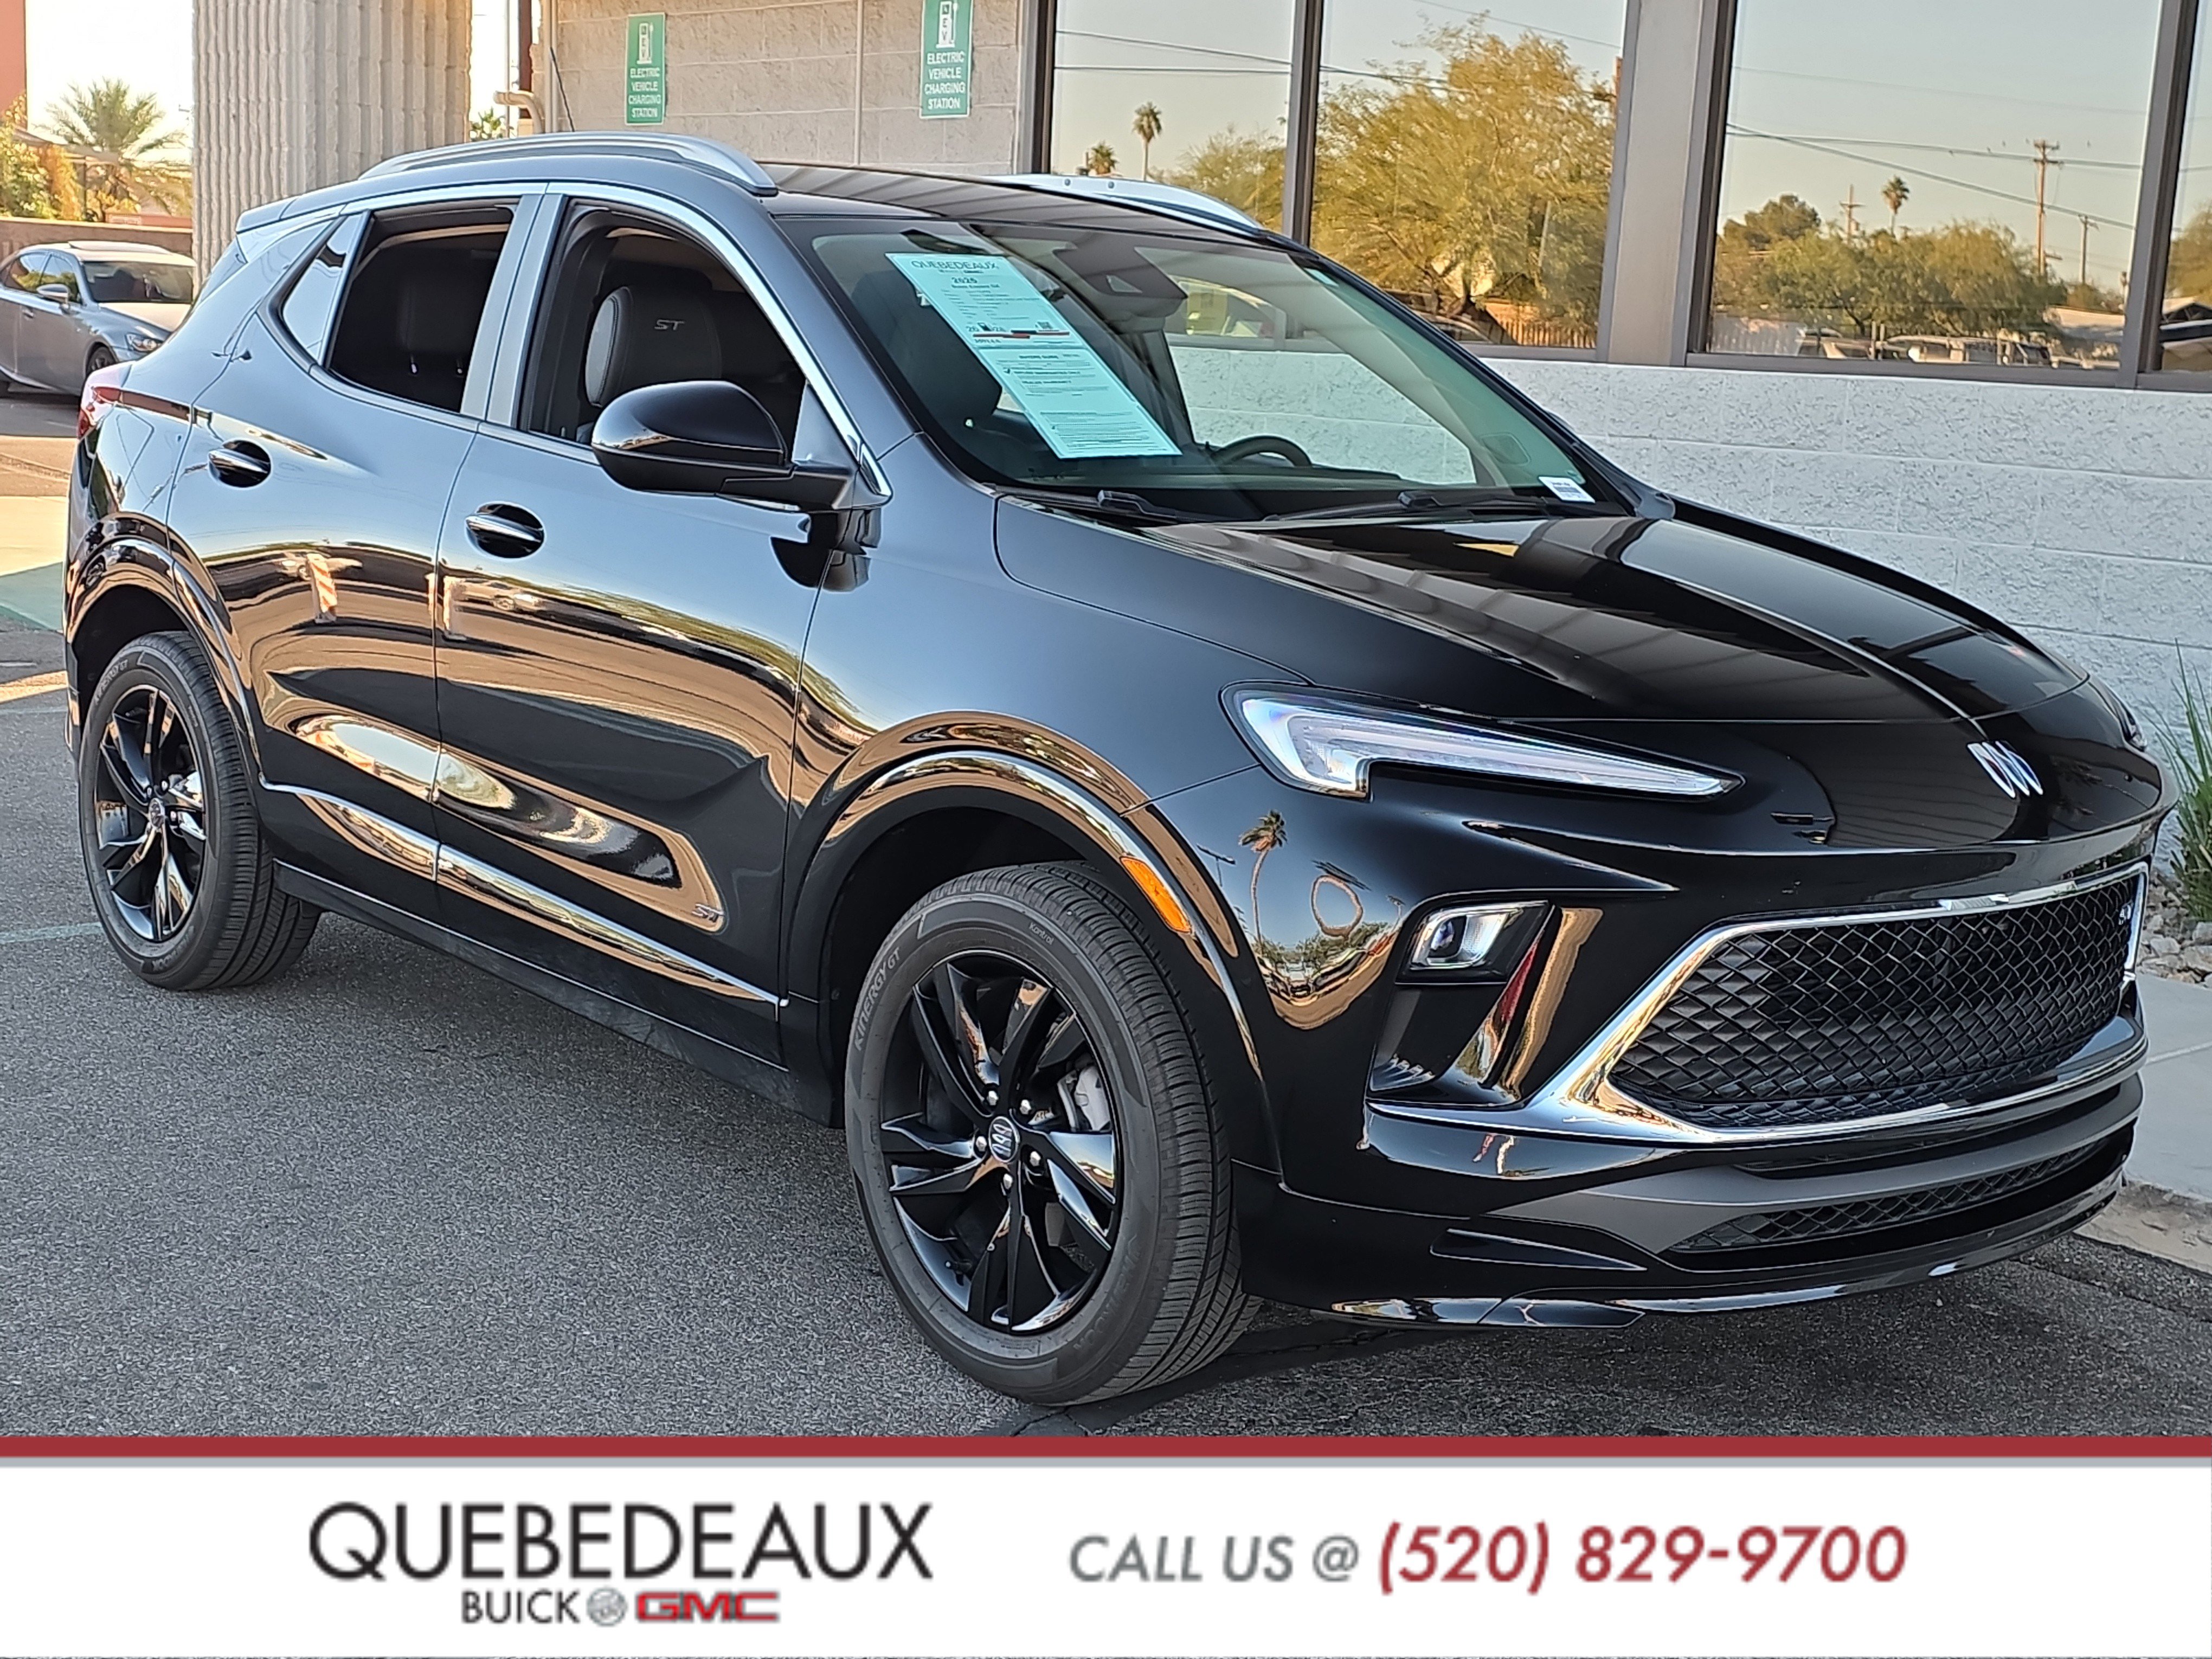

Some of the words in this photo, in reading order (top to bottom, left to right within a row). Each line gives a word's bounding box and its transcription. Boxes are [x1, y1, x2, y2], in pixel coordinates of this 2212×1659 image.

[927, 51, 965, 65] ELECTRIC
[630, 67, 660, 78] ELECTRIC
[929, 67, 962, 80] VEHICLE
[632, 81, 658, 92] VEHICLE
[924, 82, 966, 94] CHARGING
[628, 94, 661, 105] CHARGING
[928, 98, 961, 110] STATION
[632, 107, 658, 118] STATION
[911, 260, 999, 269] QUEBEDEAUX
[654, 319, 685, 330] ST
[691, 903, 725, 922] ST
[1029, 922, 1054, 944] Kontrol
[854, 961, 886, 1051] KINERGY
[888, 947, 899, 969] GT
